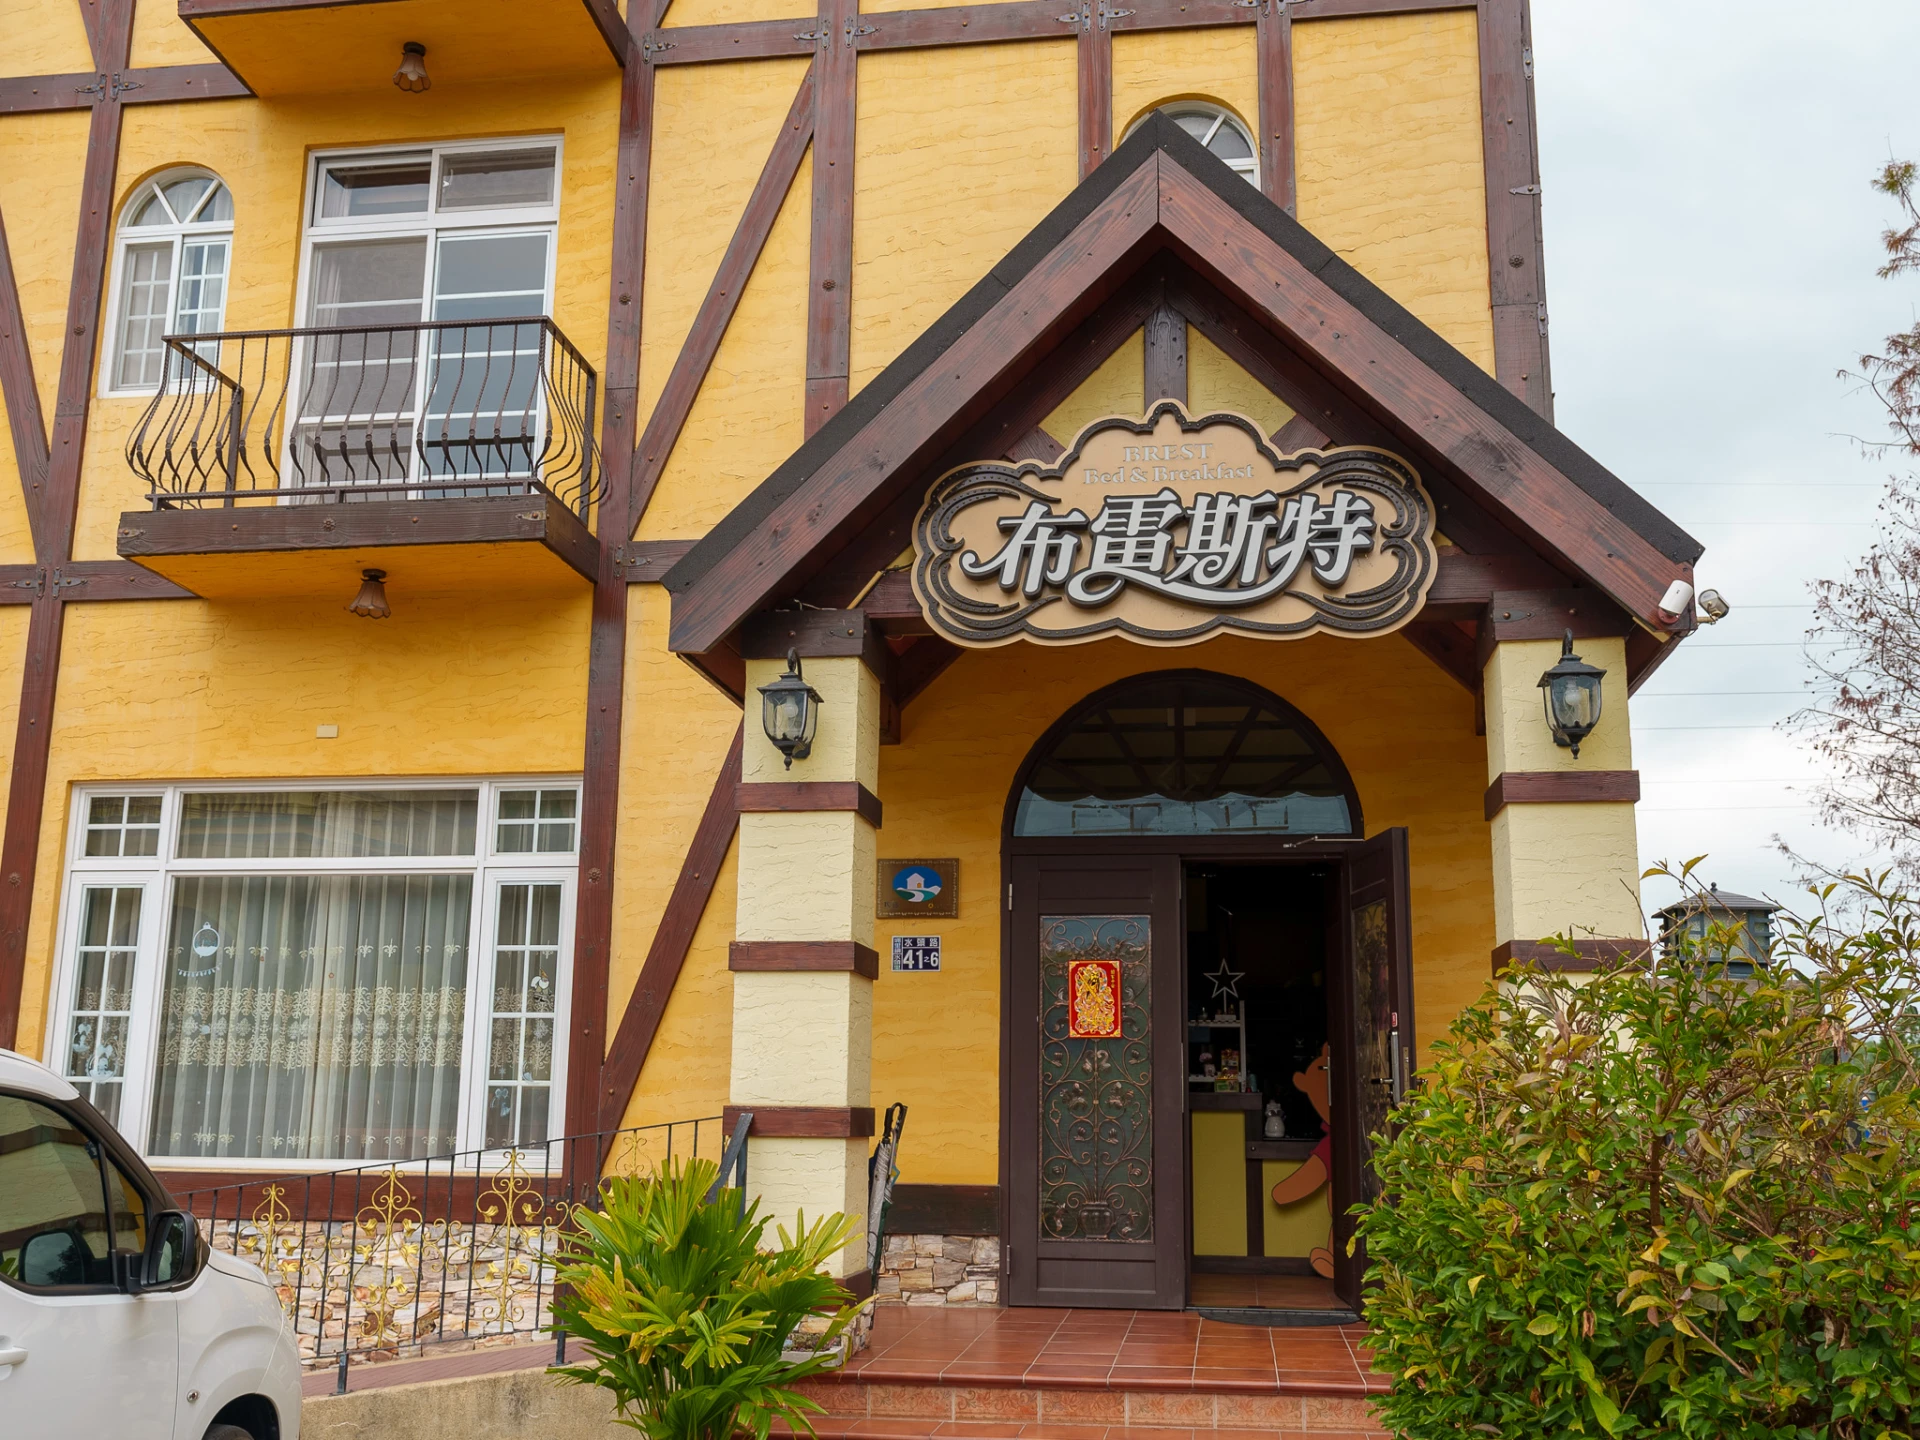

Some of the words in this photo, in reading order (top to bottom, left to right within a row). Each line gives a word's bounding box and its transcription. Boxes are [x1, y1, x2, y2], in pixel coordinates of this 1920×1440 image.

[1123, 443, 1213, 462] BREST
[1083, 466, 1125, 484] Bed
[1130, 466, 1148, 483] &
[1152, 462, 1255, 482] Breakfast
[959, 487, 1376, 608] 布雷斯特
